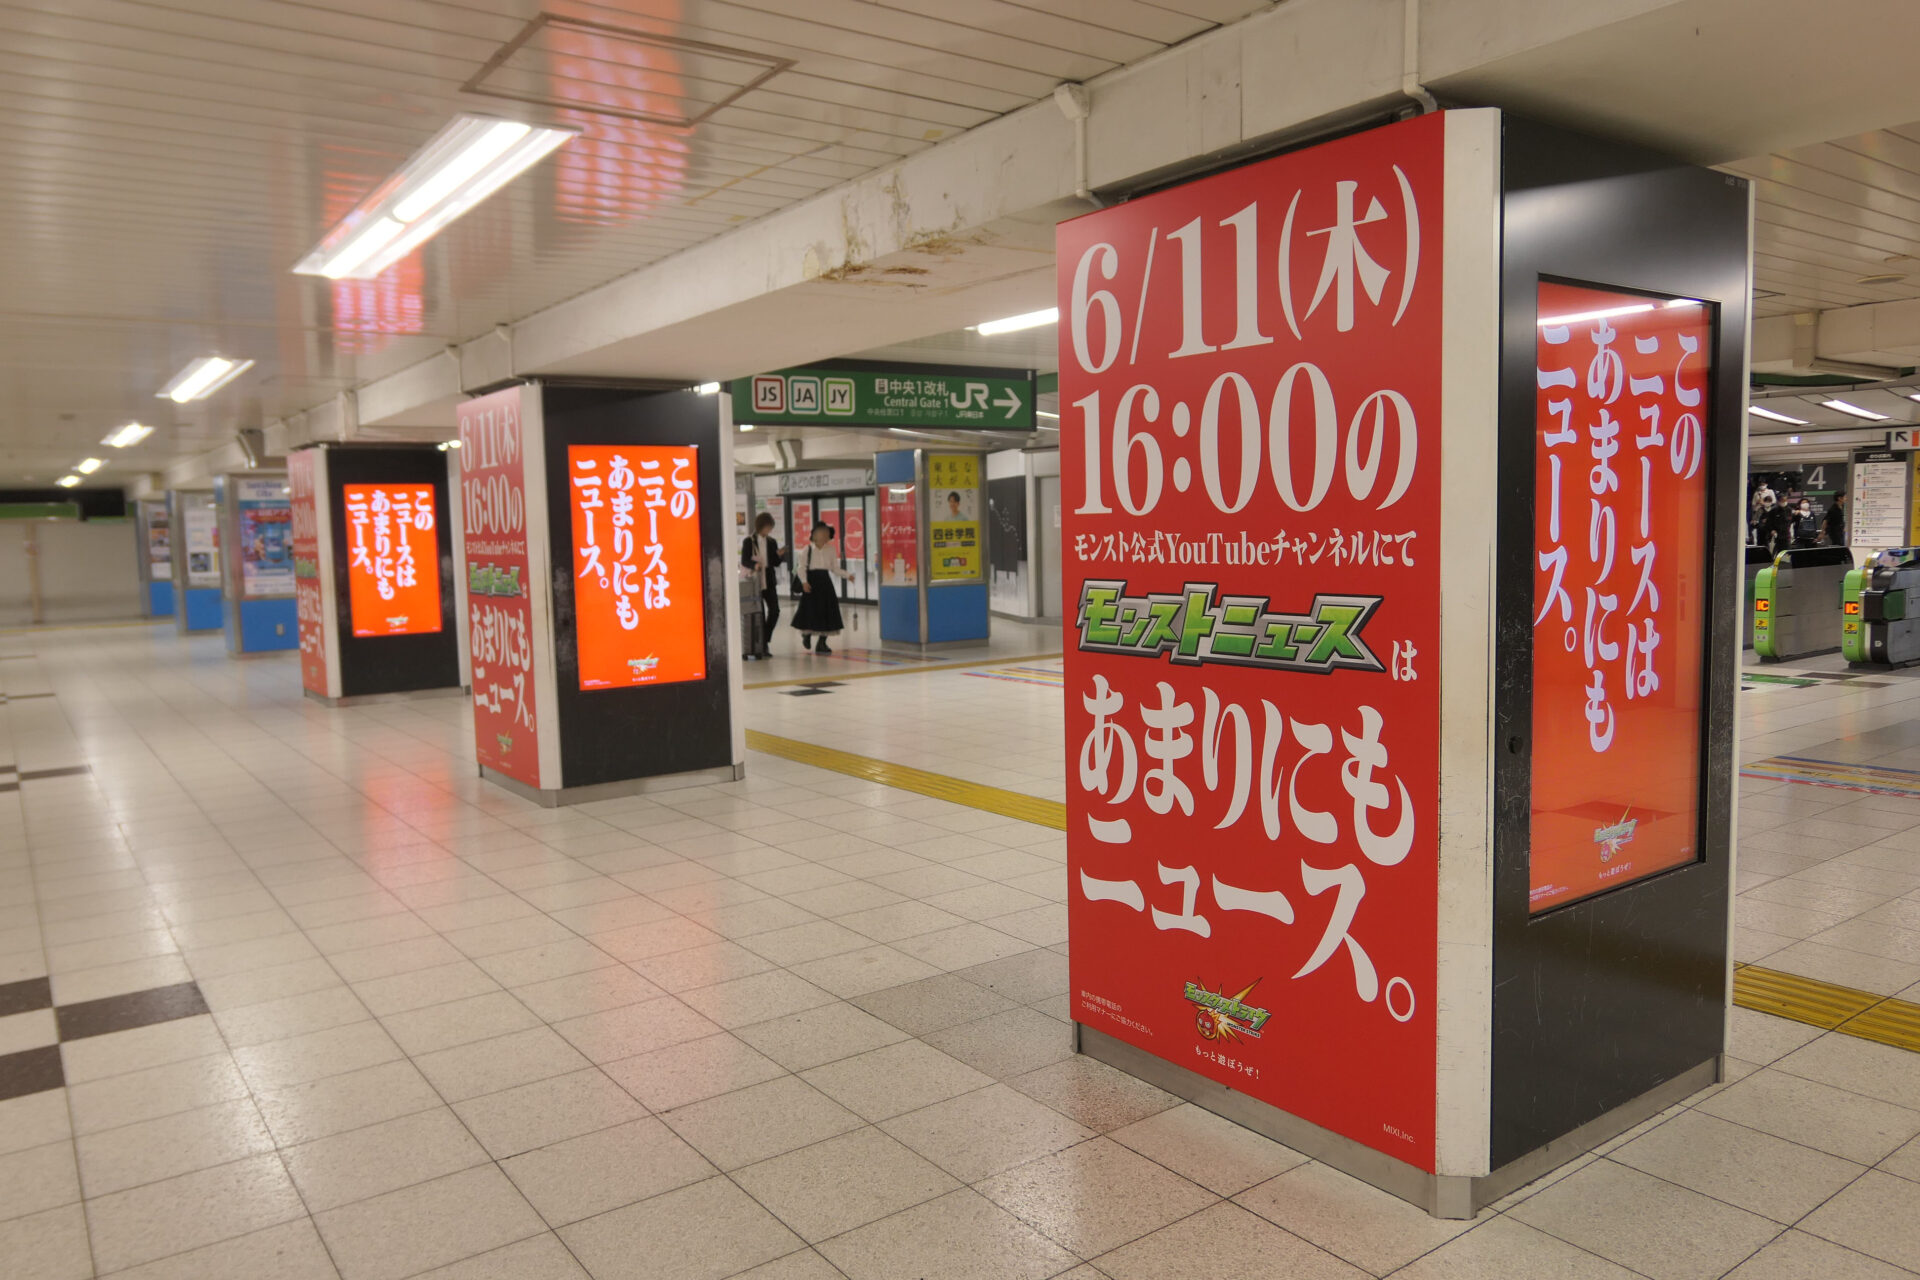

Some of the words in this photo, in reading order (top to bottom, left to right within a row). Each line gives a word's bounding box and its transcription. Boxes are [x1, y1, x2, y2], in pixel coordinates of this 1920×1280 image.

[1071, 164, 1420, 374] 6/11(木)
[760, 386, 777, 401] JS
[794, 388, 814, 403] JA
[829, 389, 848, 404] JY
[883, 396, 918, 407] Central
[920, 397, 941, 408] Gate
[944, 398, 949, 408] 1
[889, 379, 949, 397] 中央1改札
[950, 382, 989, 410] JR
[1670, 332, 1702, 480] この
[461, 404, 520, 473] 6/11(木)
[1072, 362, 1418, 516] 16:00の
[414, 491, 434, 531] この
[463, 474, 524, 535] 16:00の
[670, 457, 696, 520] この
[1534, 323, 1577, 652] ニュース。
[1806, 466, 1827, 490] 4
[347, 492, 374, 574] ニュース。
[371, 489, 395, 600] あまりにも
[391, 492, 416, 587] ニュースは
[573, 459, 609, 589] ニュース。
[608, 454, 639, 630] あまりにも
[638, 460, 671, 609] ニュースは
[1073, 528, 1418, 568] モンスト公式YouTubeチャンネルにて
[1584, 317, 1624, 752] あまりにも
[1626, 335, 1664, 700] ニュースは
[472, 603, 530, 672] あまりにも
[1078, 580, 1380, 673] モンストニュース
[1391, 639, 1418, 682] は
[1756, 600, 1769, 610] IC
[1845, 603, 1859, 614] IC
[474, 667, 535, 733] ニュース。
[1079, 673, 1415, 866] あまりにも
[1080, 812, 1415, 1022] ニュース。
[1184, 982, 1271, 1031] モンスターストライク
